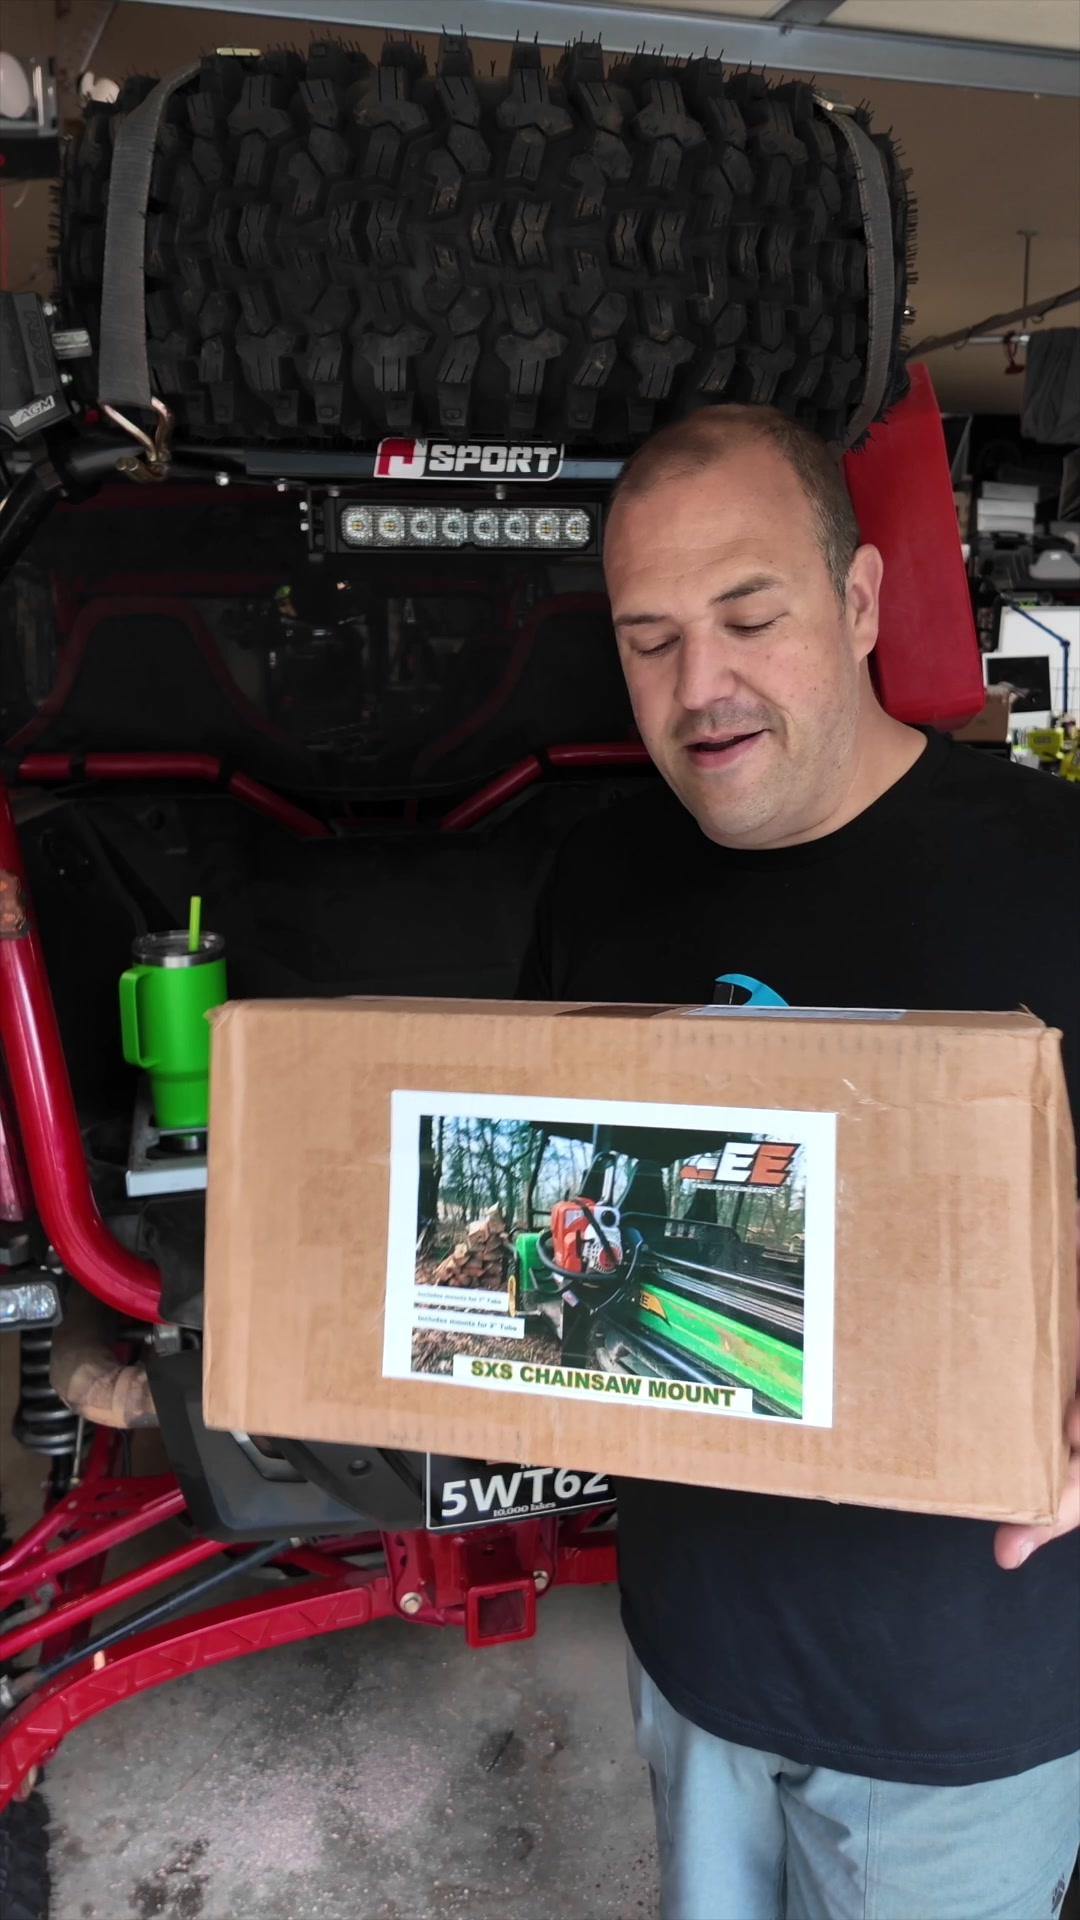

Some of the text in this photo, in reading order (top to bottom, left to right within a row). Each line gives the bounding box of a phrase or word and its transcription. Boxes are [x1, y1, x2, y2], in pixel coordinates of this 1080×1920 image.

[20, 397, 54, 422] AGM
[429, 445, 557, 472] SPORT
[417, 1291, 443, 1299] Includes
[417, 1315, 447, 1323] Includes
[449, 1319, 476, 1327] mounts
[500, 1324, 518, 1332] Tube
[470, 1360, 736, 1407] SXS CHAINSAW MOUNT
[441, 1467, 609, 1518] 5WT62
[530, 1501, 556, 1511] lakes
